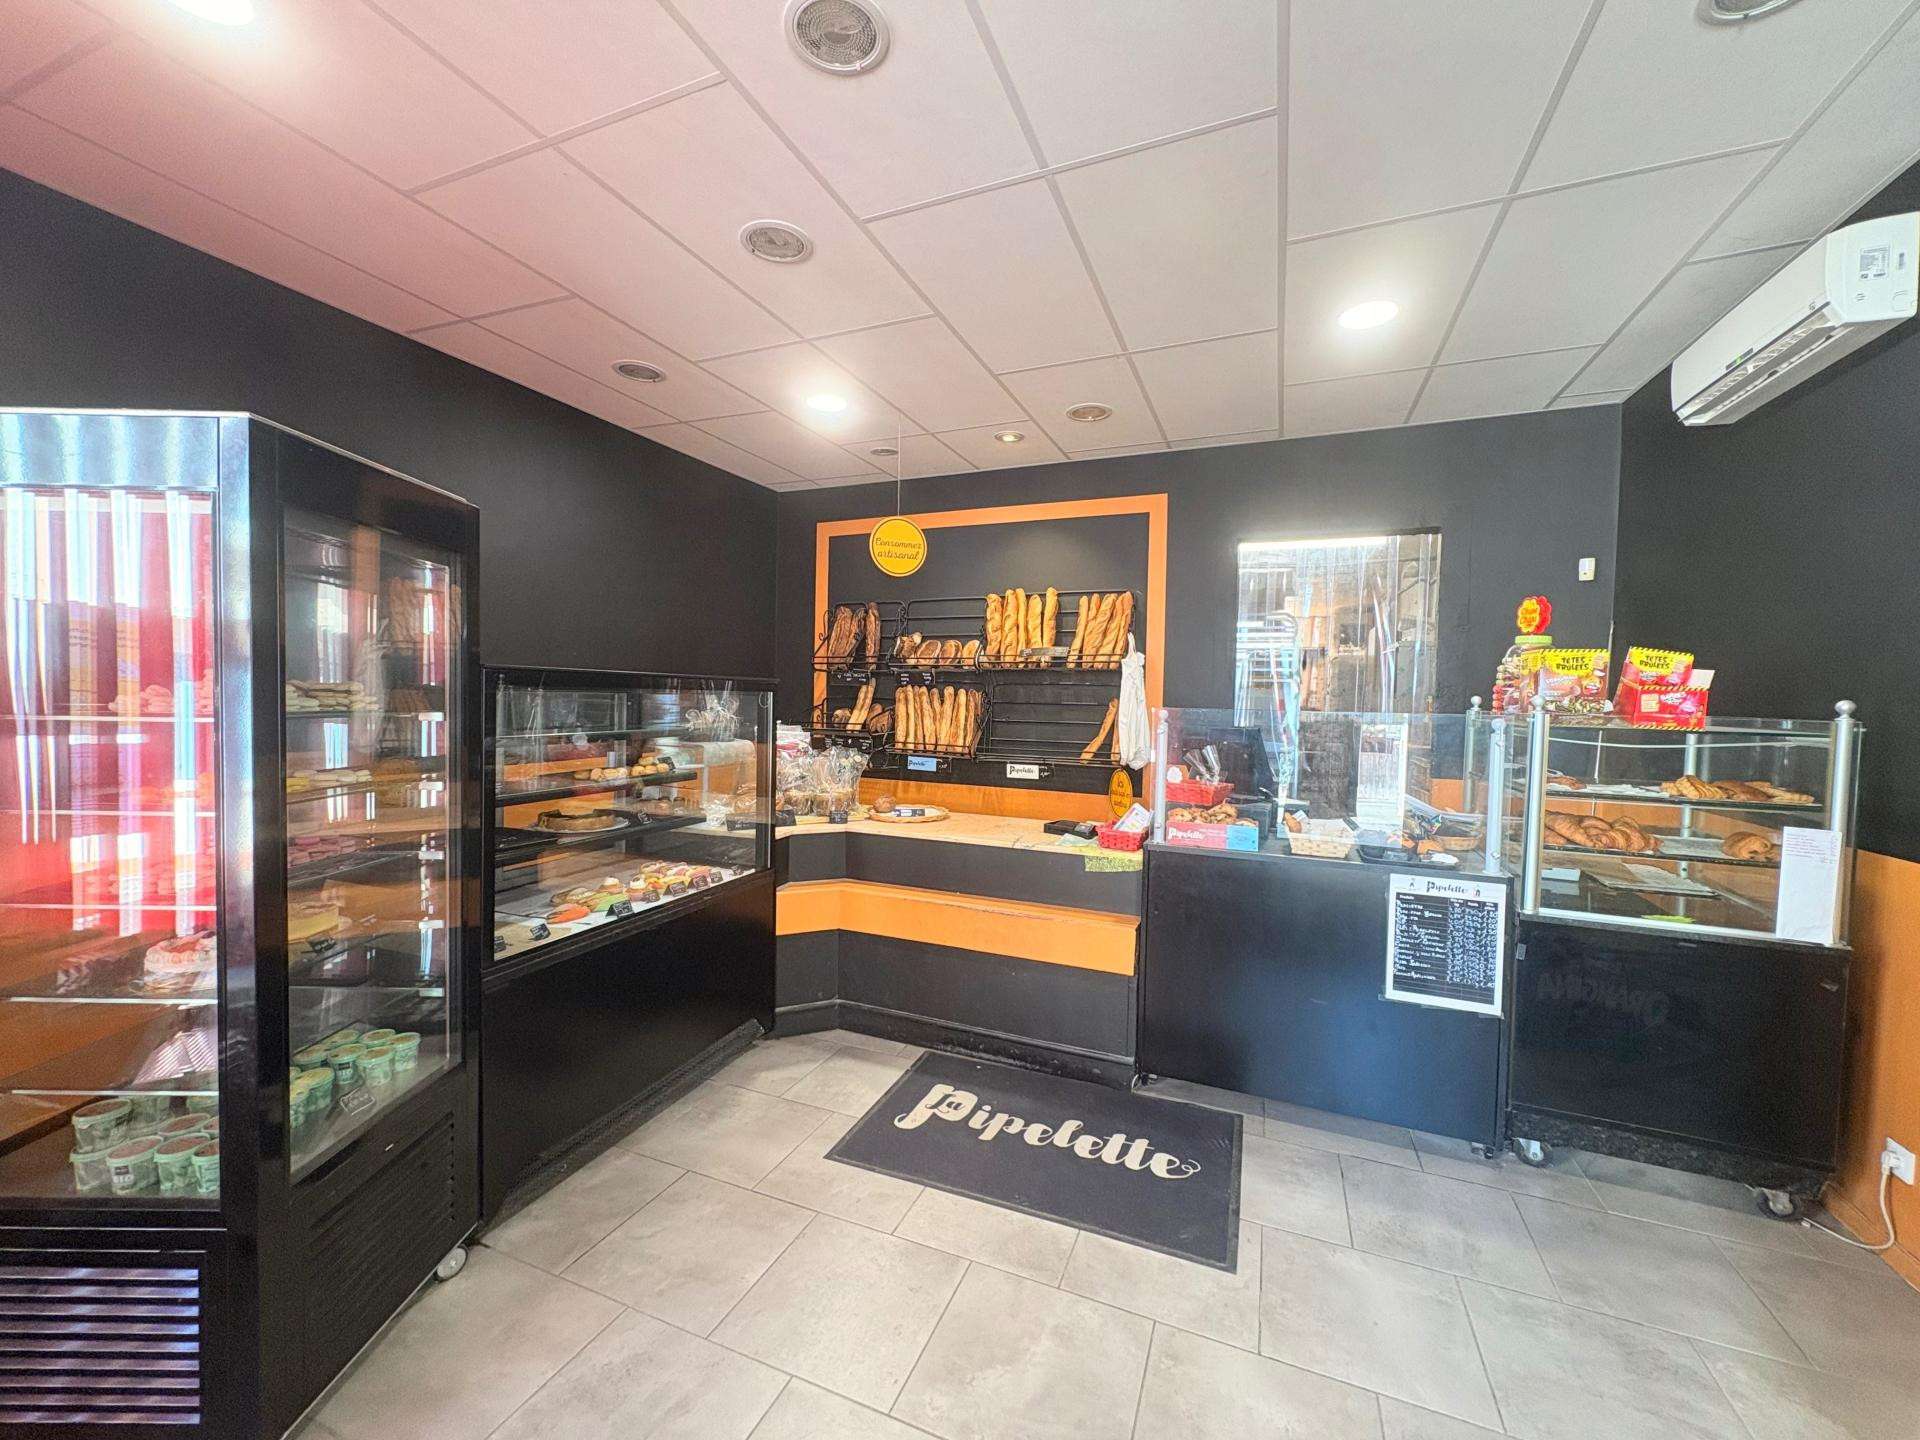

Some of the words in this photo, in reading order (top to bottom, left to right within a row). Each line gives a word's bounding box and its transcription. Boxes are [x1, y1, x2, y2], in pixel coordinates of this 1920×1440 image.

[877, 550, 920, 560] artisanal
[1426, 880, 1467, 893] Pipelette
[893, 1083, 1201, 1179] Pipelette
